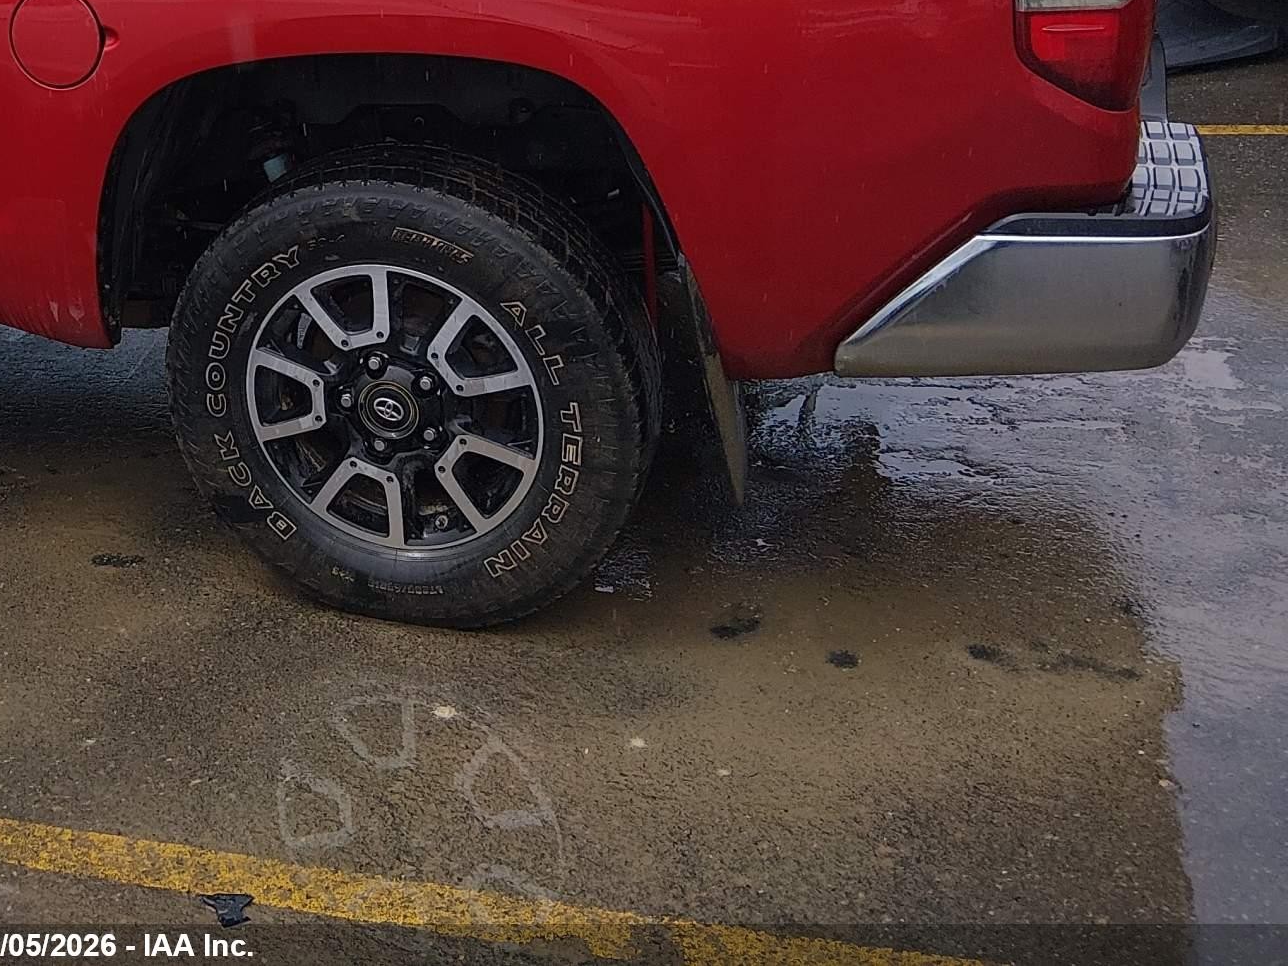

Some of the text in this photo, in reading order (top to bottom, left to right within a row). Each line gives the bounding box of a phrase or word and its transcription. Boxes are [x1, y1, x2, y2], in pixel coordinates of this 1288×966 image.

[206, 245, 300, 540] BACK COUNTRY
[484, 301, 583, 578] ALL TERRAIN
